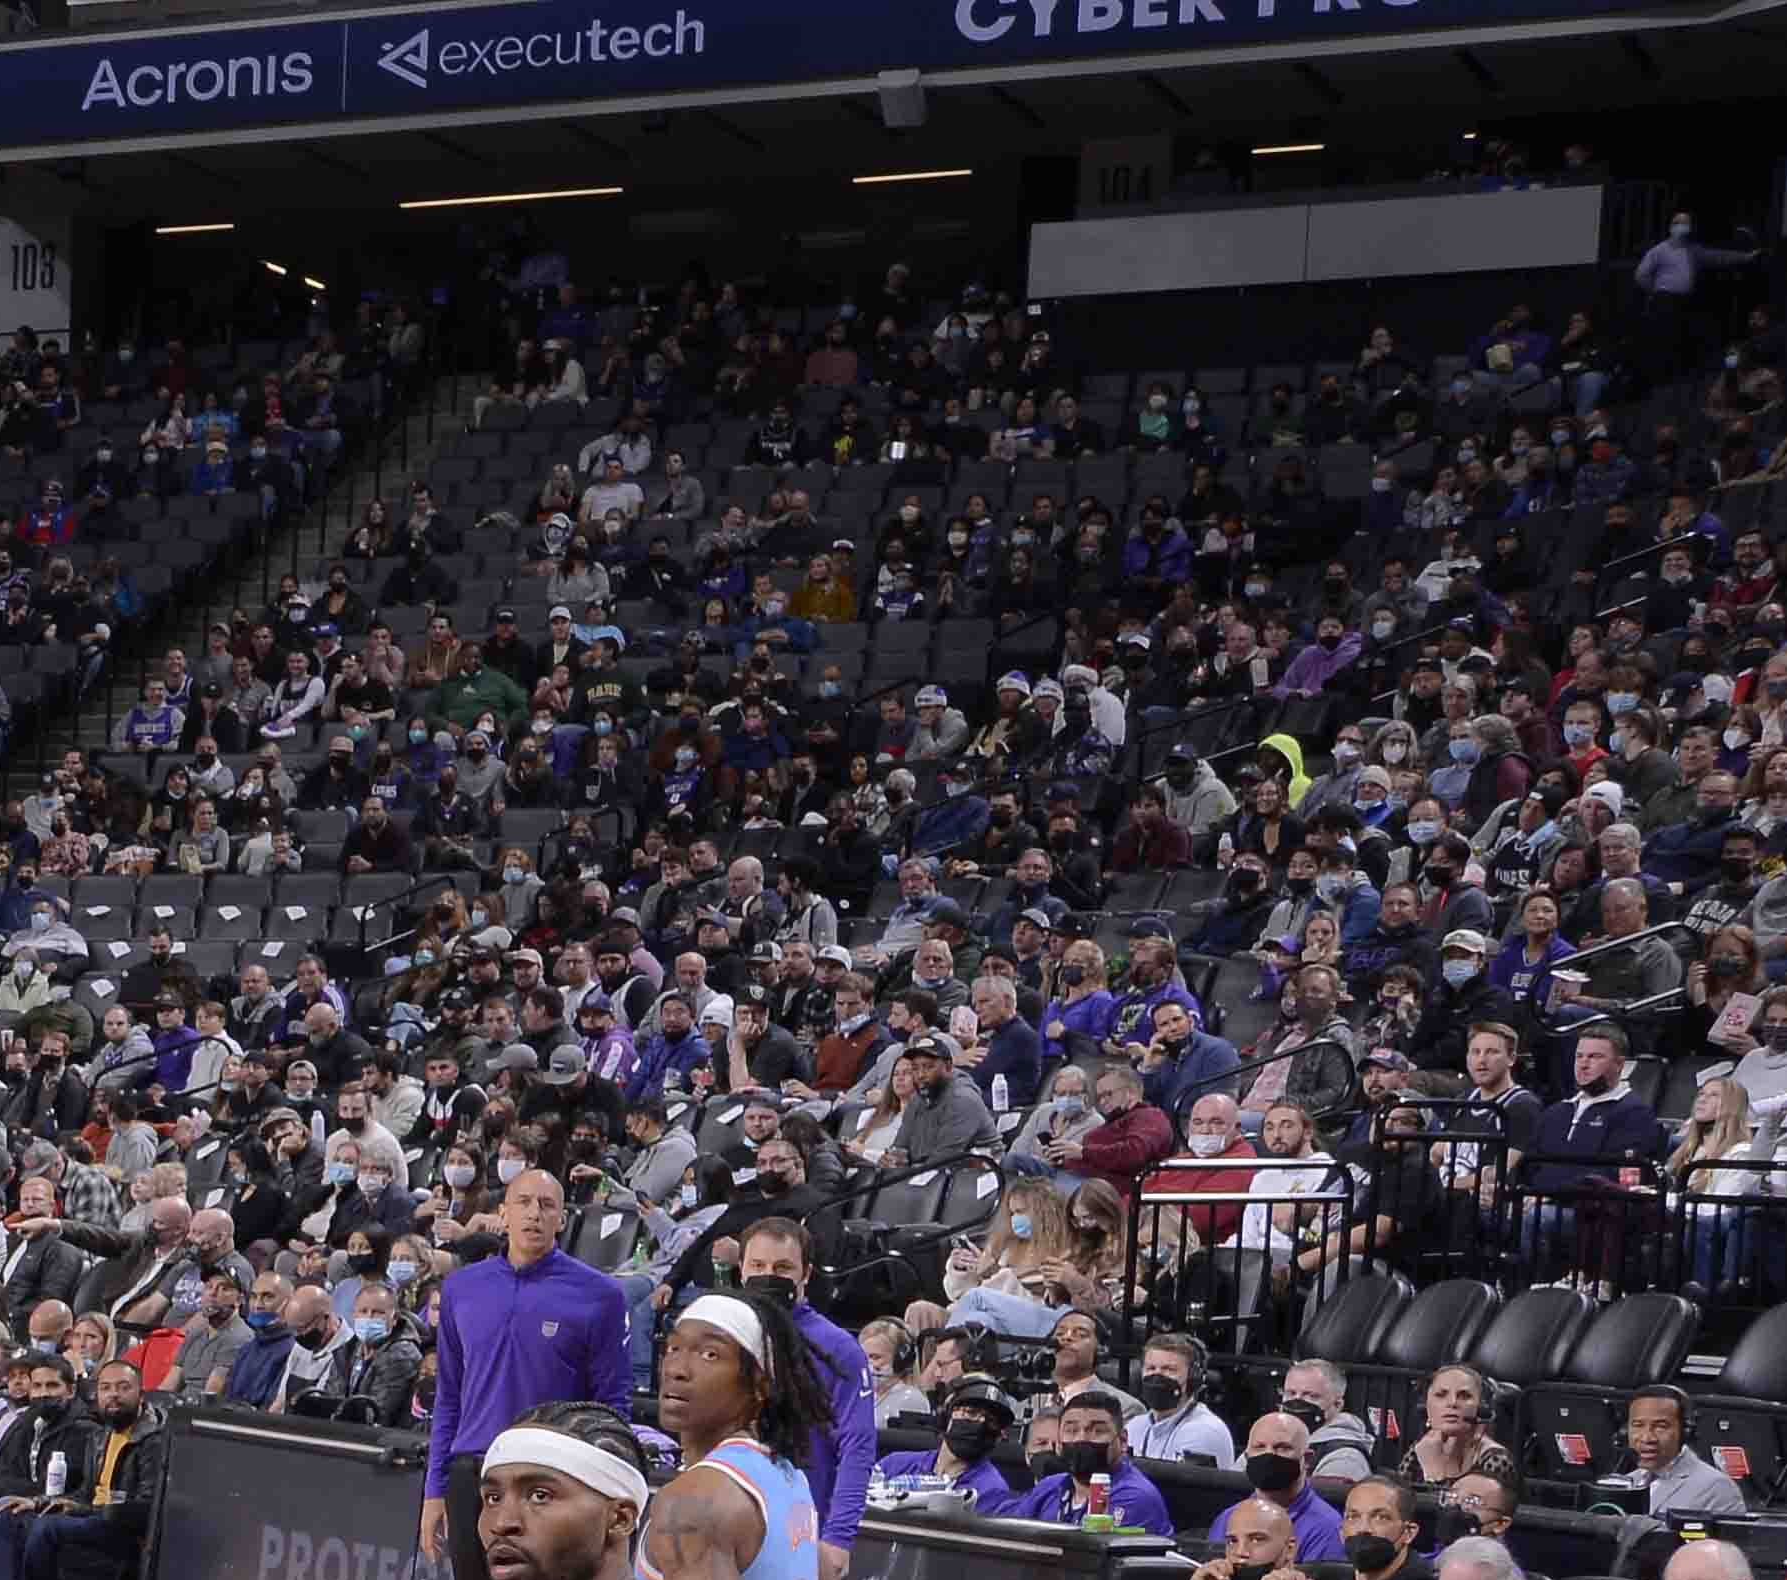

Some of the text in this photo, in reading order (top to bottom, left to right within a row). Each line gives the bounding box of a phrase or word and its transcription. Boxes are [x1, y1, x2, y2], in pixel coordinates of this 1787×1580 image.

[438, 10, 706, 76] executech
[81, 51, 313, 112] Acronis
[10, 243, 57, 291] 103
